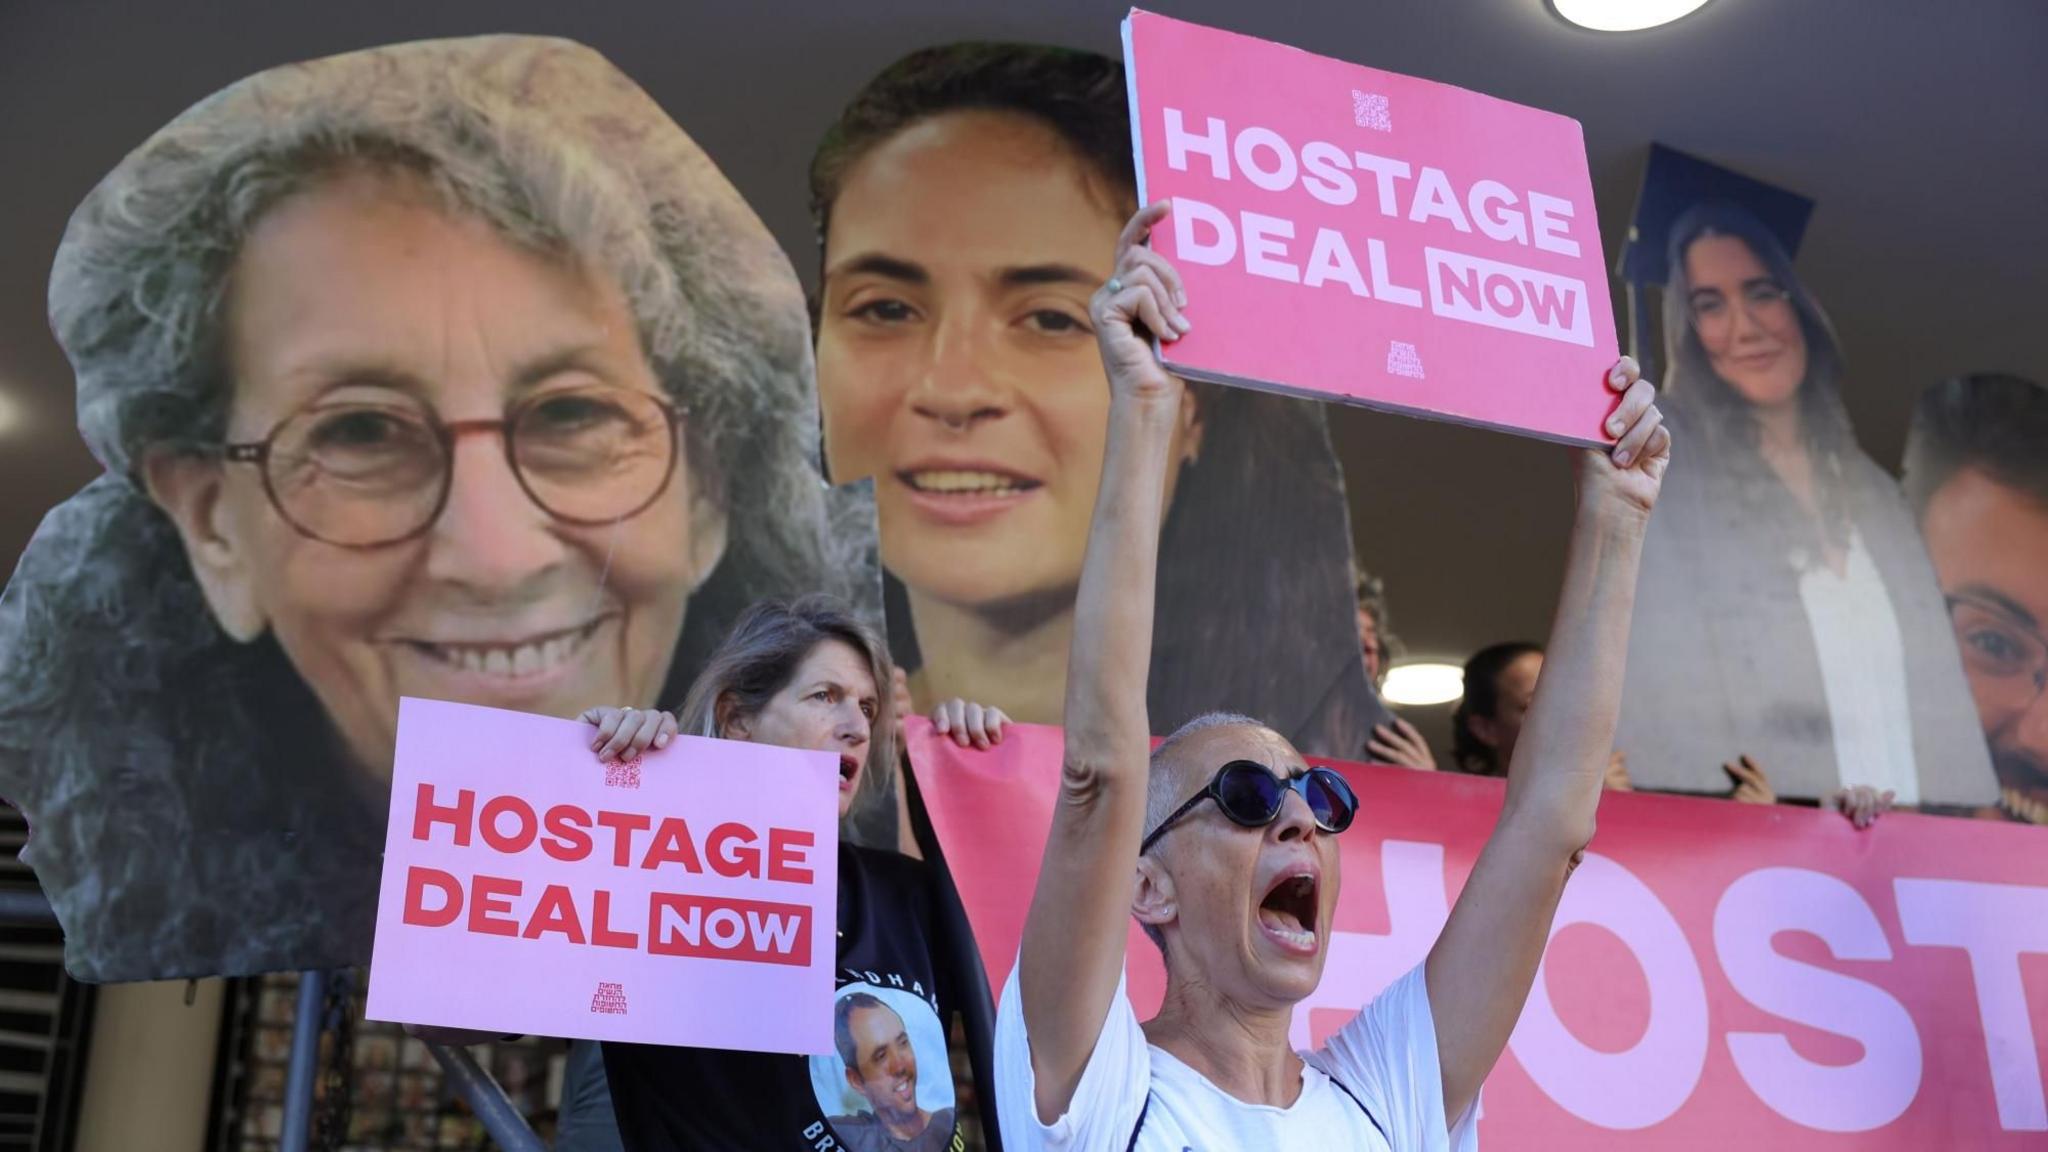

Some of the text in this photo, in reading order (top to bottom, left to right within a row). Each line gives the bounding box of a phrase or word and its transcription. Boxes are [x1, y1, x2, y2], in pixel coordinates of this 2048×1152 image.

[1163, 107, 1581, 258] HOSTAGE
[1171, 196, 1576, 330] DEAL NOW
[413, 783, 814, 884] HOSTAGE
[403, 866, 801, 954] DEAL NOW
